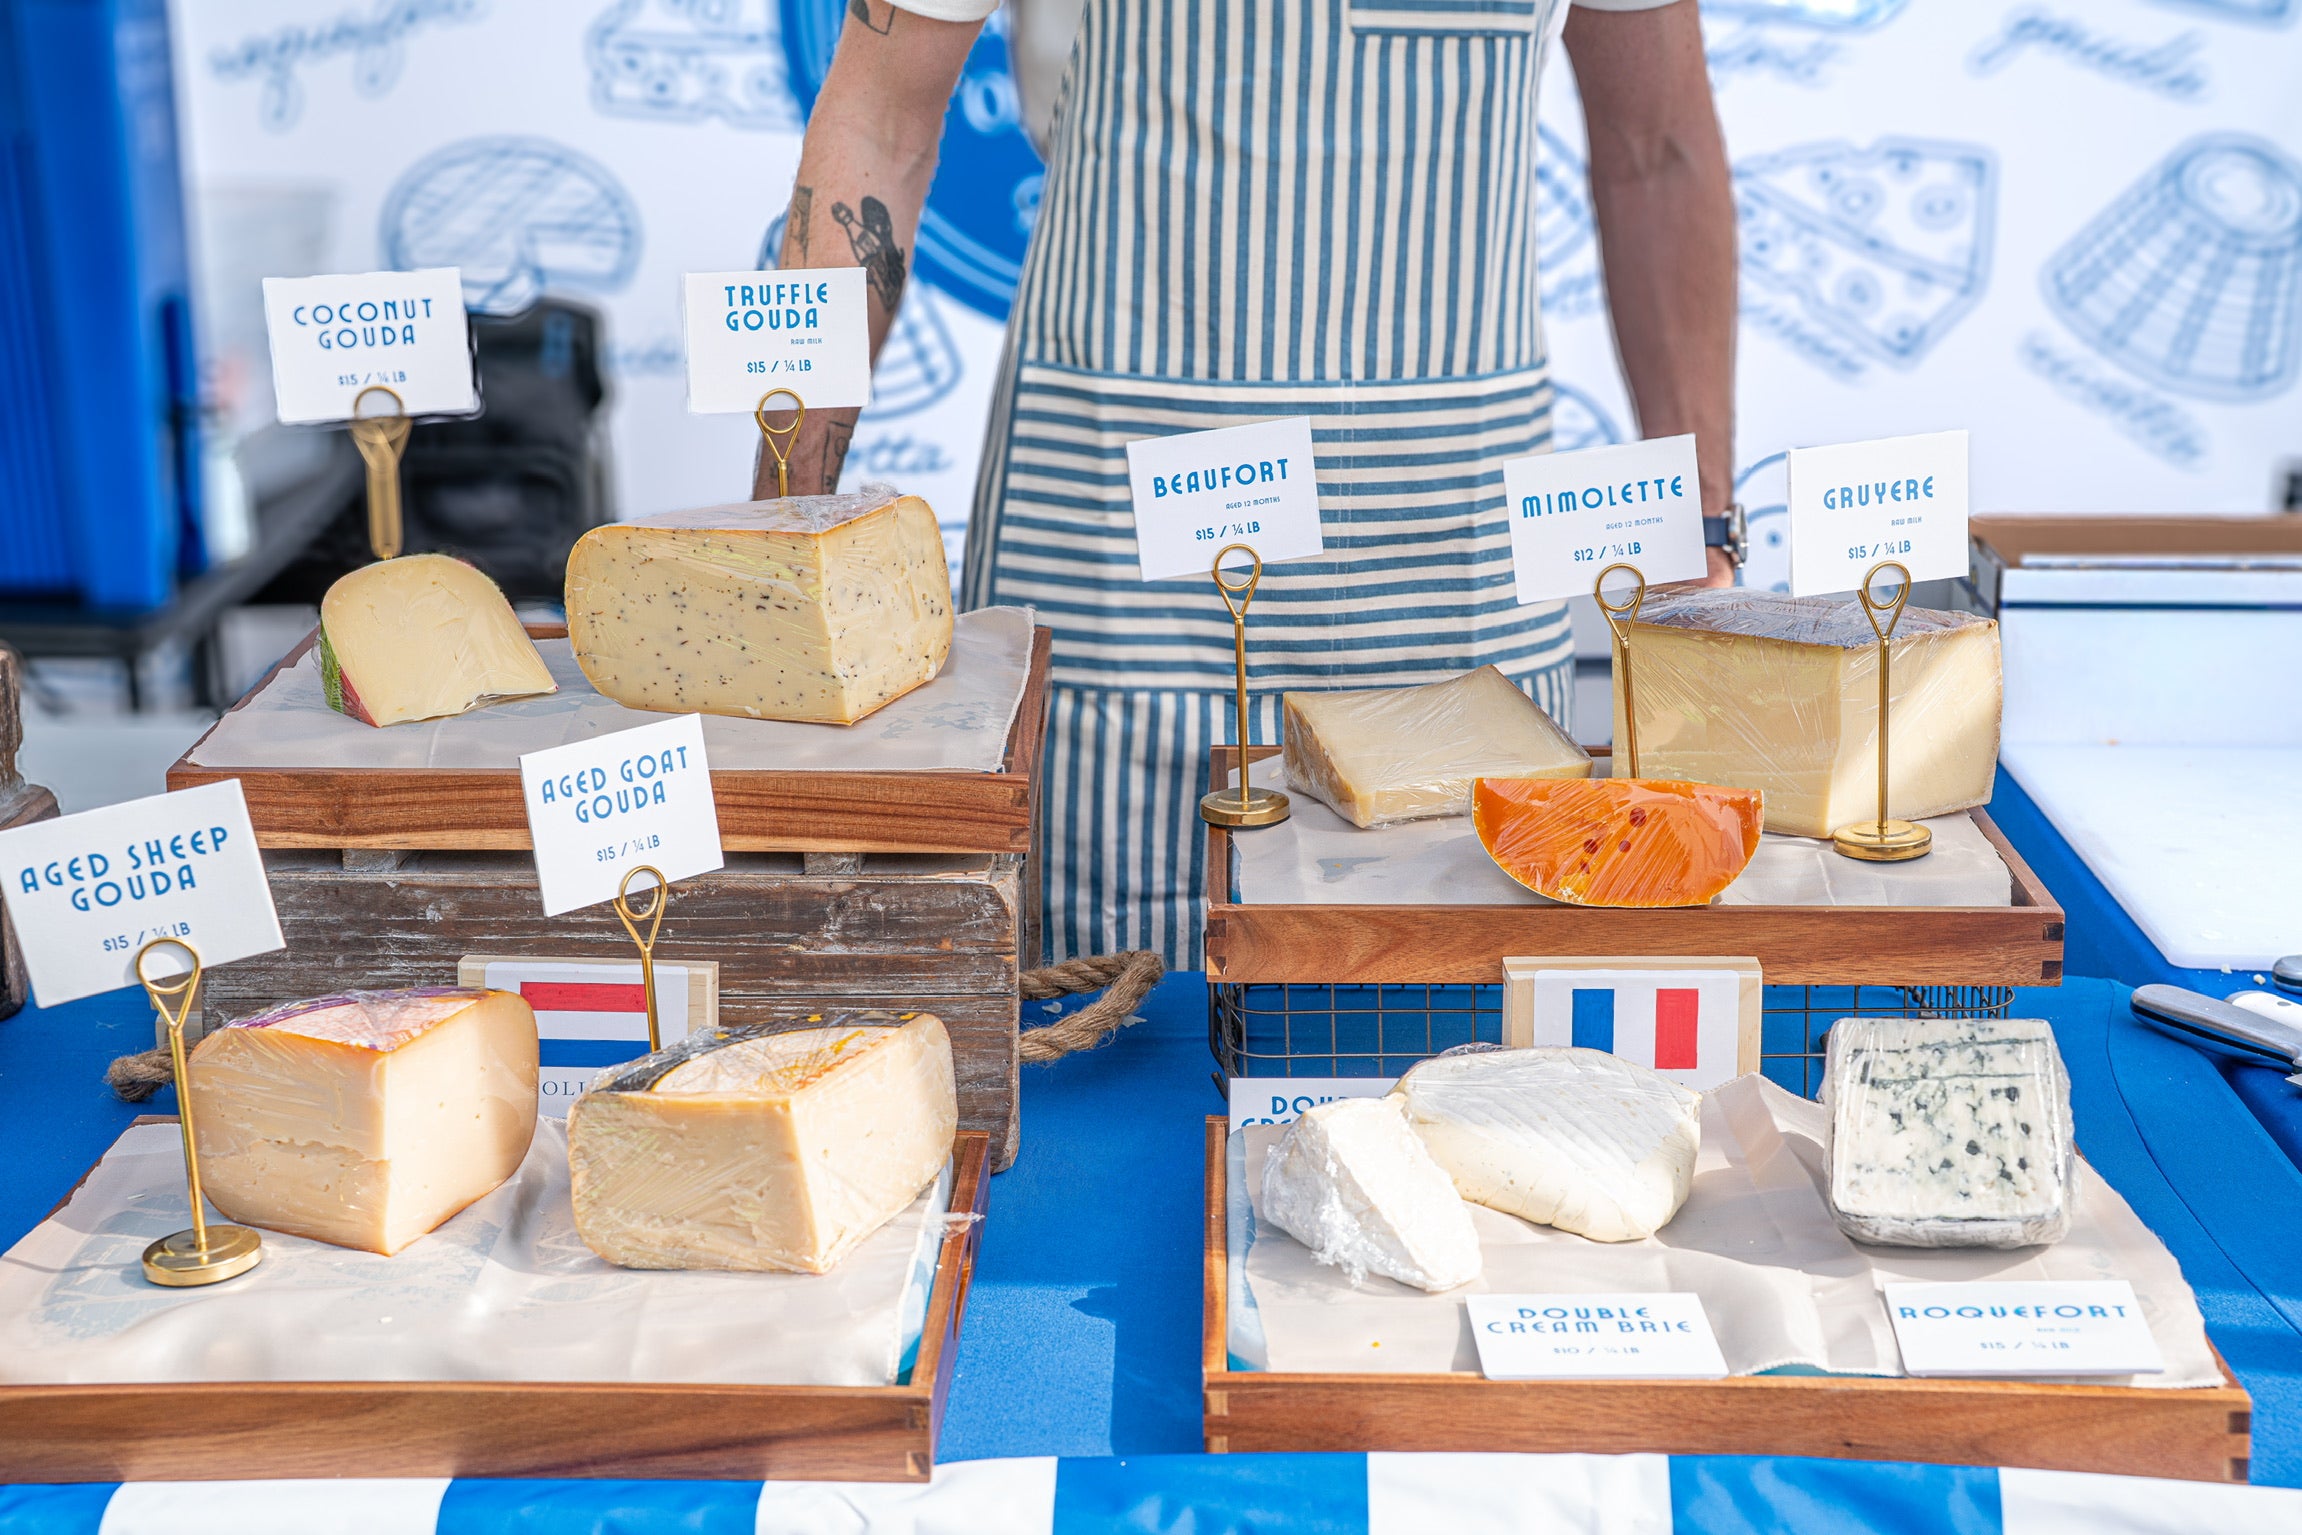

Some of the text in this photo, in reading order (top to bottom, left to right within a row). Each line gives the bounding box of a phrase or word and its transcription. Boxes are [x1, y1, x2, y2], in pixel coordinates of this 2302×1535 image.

[725, 282, 828, 307] TRUFFLE
[294, 299, 432, 326] COCONUT
[726, 308, 818, 332] GOUDA
[319, 324, 415, 350] GOUDA
[807, 337, 823, 345] MILK
[747, 361, 766, 373] $15
[799, 359, 812, 372] LB
[338, 374, 358, 386] $15
[393, 371, 407, 383] LB
[1153, 458, 1288, 498] BEAUFORT
[1225, 496, 1281, 510] AGED 12 MONTHS
[1522, 475, 1683, 518] MIMOLETTE
[1823, 475, 1933, 510] GRUYERE
[1195, 527, 1215, 541] $15
[1247, 521, 1260, 534] LB
[1605, 522, 1623, 530] AGED
[1634, 517, 1663, 527] MONTHS
[1891, 516, 1922, 526] RAW MILK
[1574, 548, 1594, 562] $12
[1628, 541, 1642, 555] LB
[1848, 546, 1867, 559] $15
[1899, 540, 1911, 553] LB
[542, 745, 687, 804] AGED GOAT
[575, 780, 666, 823] GOUDA
[20, 826, 228, 894] AGED SHEEP
[597, 846, 616, 862] $15
[647, 834, 660, 849] LB
[71, 864, 197, 912] GOUDA
[103, 935, 129, 951] $15
[172, 922, 190, 937] LB
[1517, 1307, 1650, 1320] DOUBLE
[1898, 1305, 2126, 1320] ROQUEFORT
[1486, 1320, 1692, 1334] CREAM BRIE
